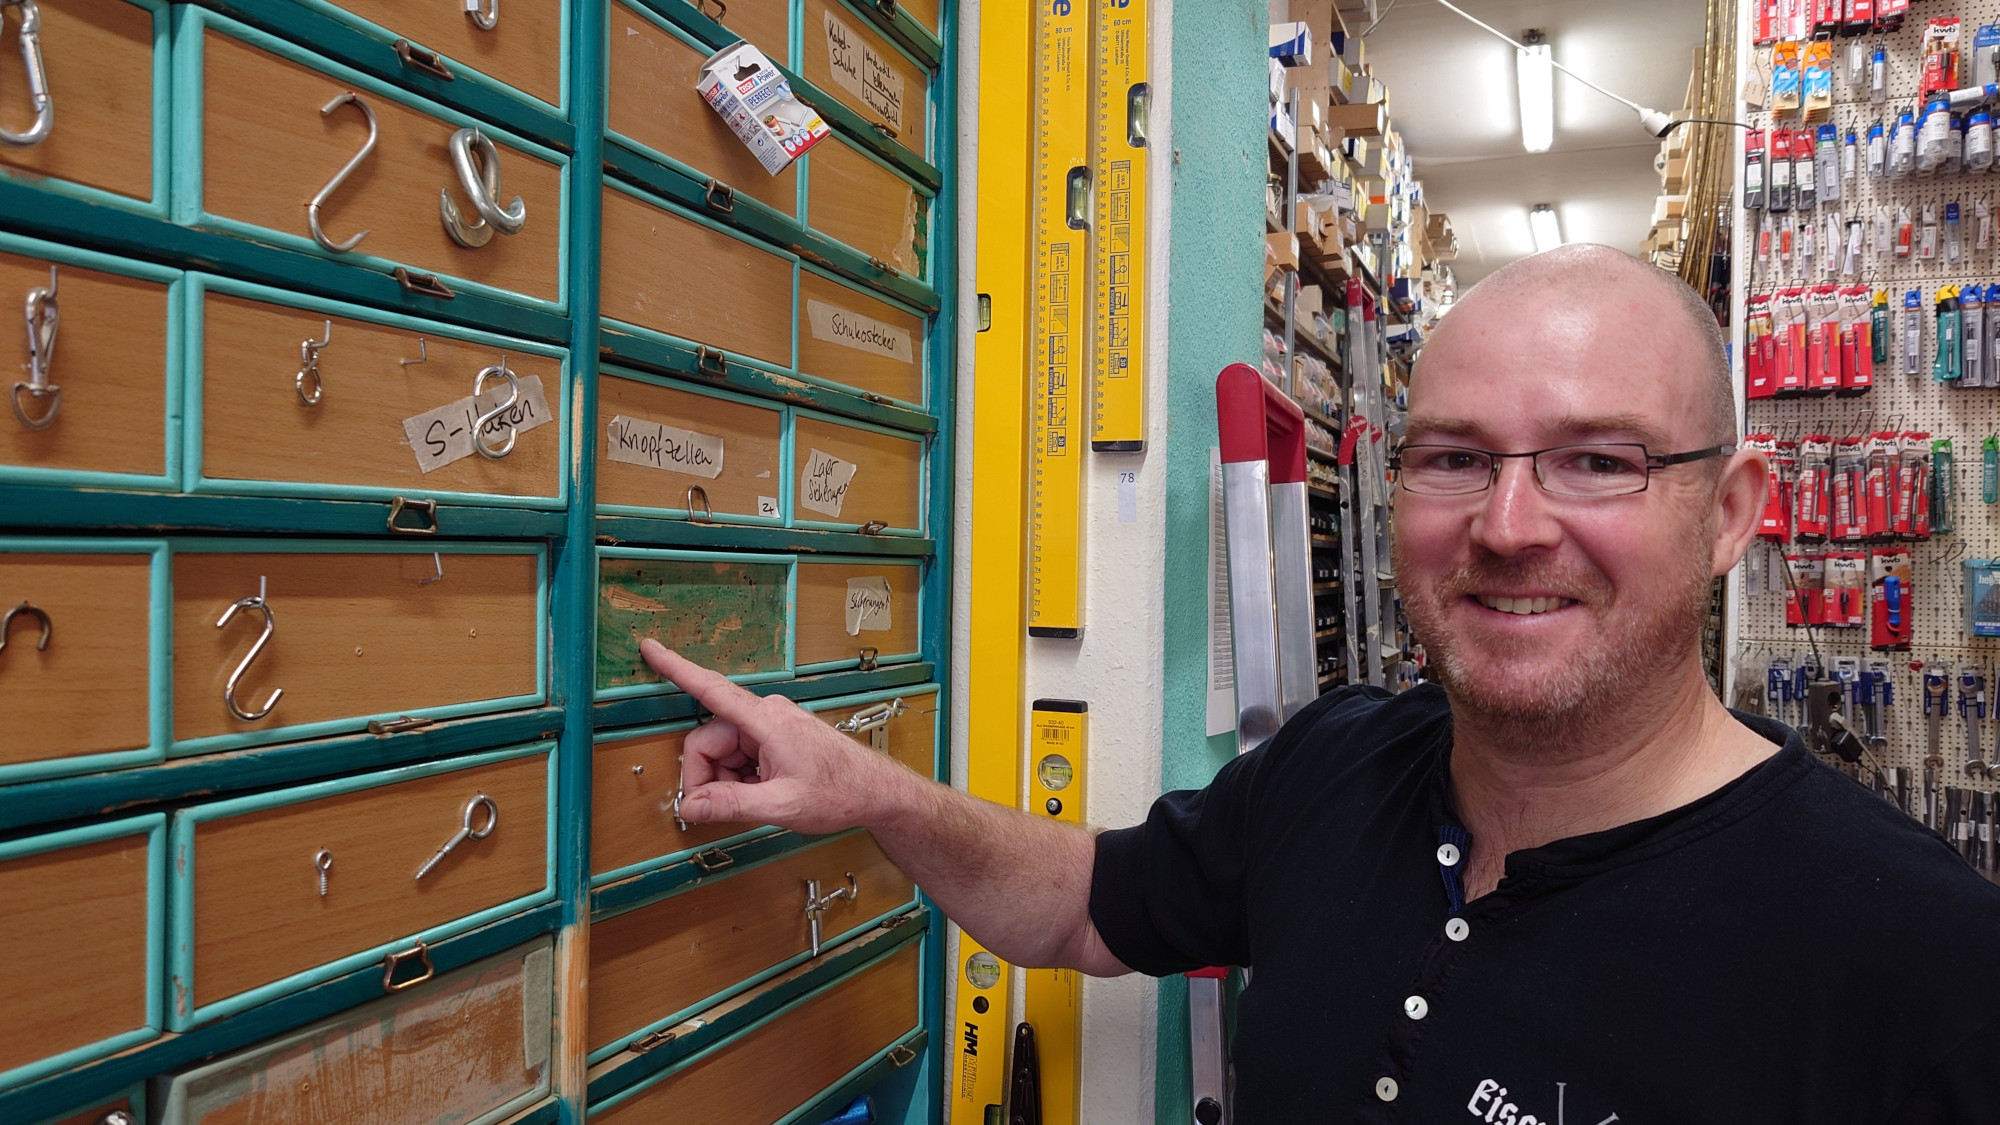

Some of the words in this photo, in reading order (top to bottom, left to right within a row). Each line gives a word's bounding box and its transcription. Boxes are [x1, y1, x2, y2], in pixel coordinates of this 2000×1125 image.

[757, 69, 776, 84] Power
[740, 82, 754, 95] tesa
[748, 86, 773, 107] PERFECT
[1782, 294, 1803, 304] kwb
[1814, 292, 1836, 303] kwb
[1845, 294, 1867, 304] kwb
[831, 313, 896, 351] Schukostecker
[1120, 358, 1126, 367] 30
[619, 424, 712, 467] Knopfzellen
[1058, 438, 1064, 446] 30
[1775, 450, 1793, 458] kwb
[1838, 445, 1860, 453] kwb
[1120, 473, 1135, 483] 78
